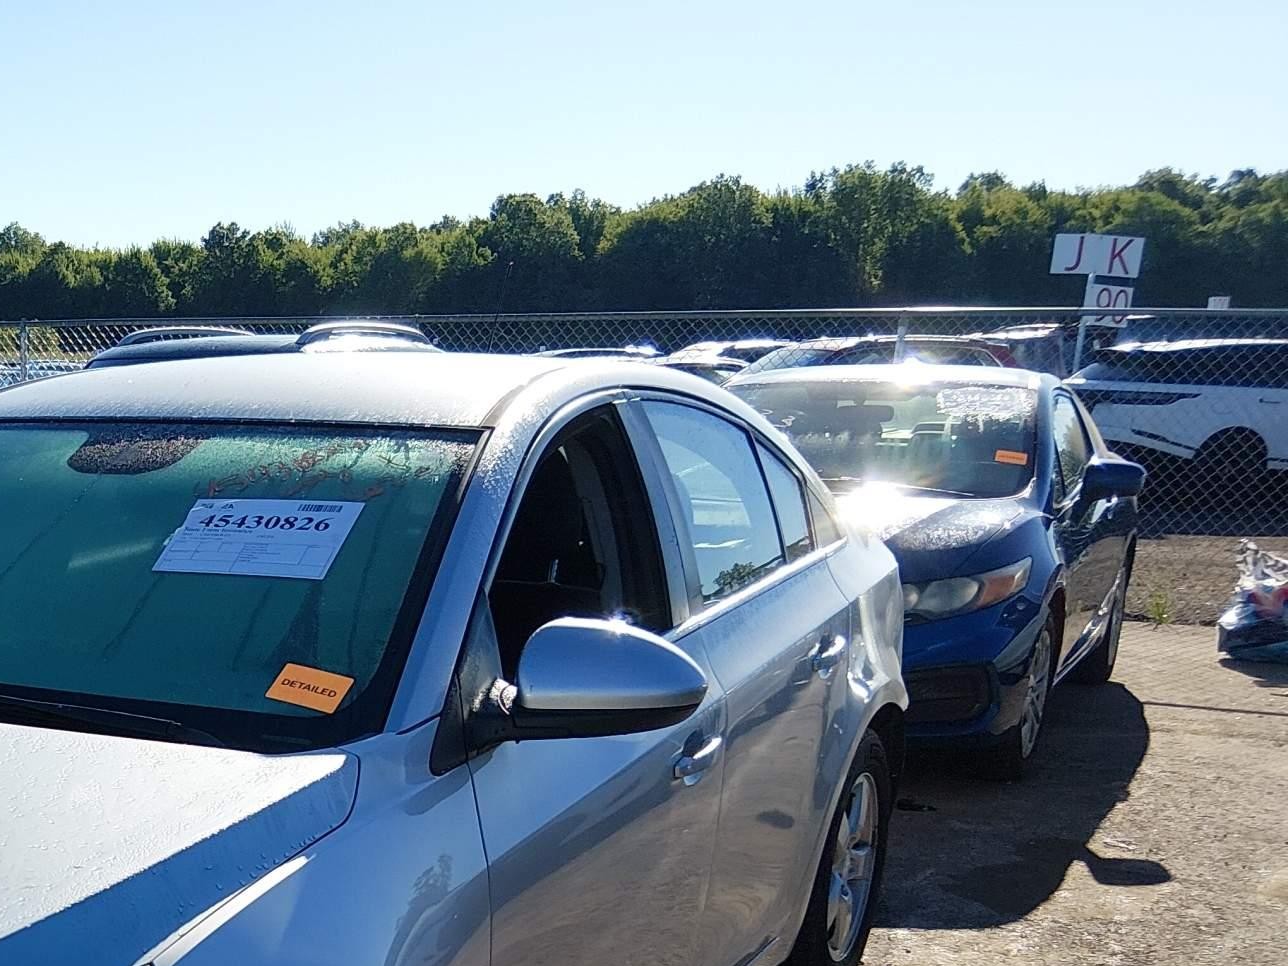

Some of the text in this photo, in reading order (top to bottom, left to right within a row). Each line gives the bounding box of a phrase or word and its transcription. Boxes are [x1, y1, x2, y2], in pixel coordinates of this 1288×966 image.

[1064, 235, 1136, 275] J K
[1094, 287, 1129, 324] 90
[198, 514, 336, 532] 45430826
[280, 678, 338, 698] DETAILED
